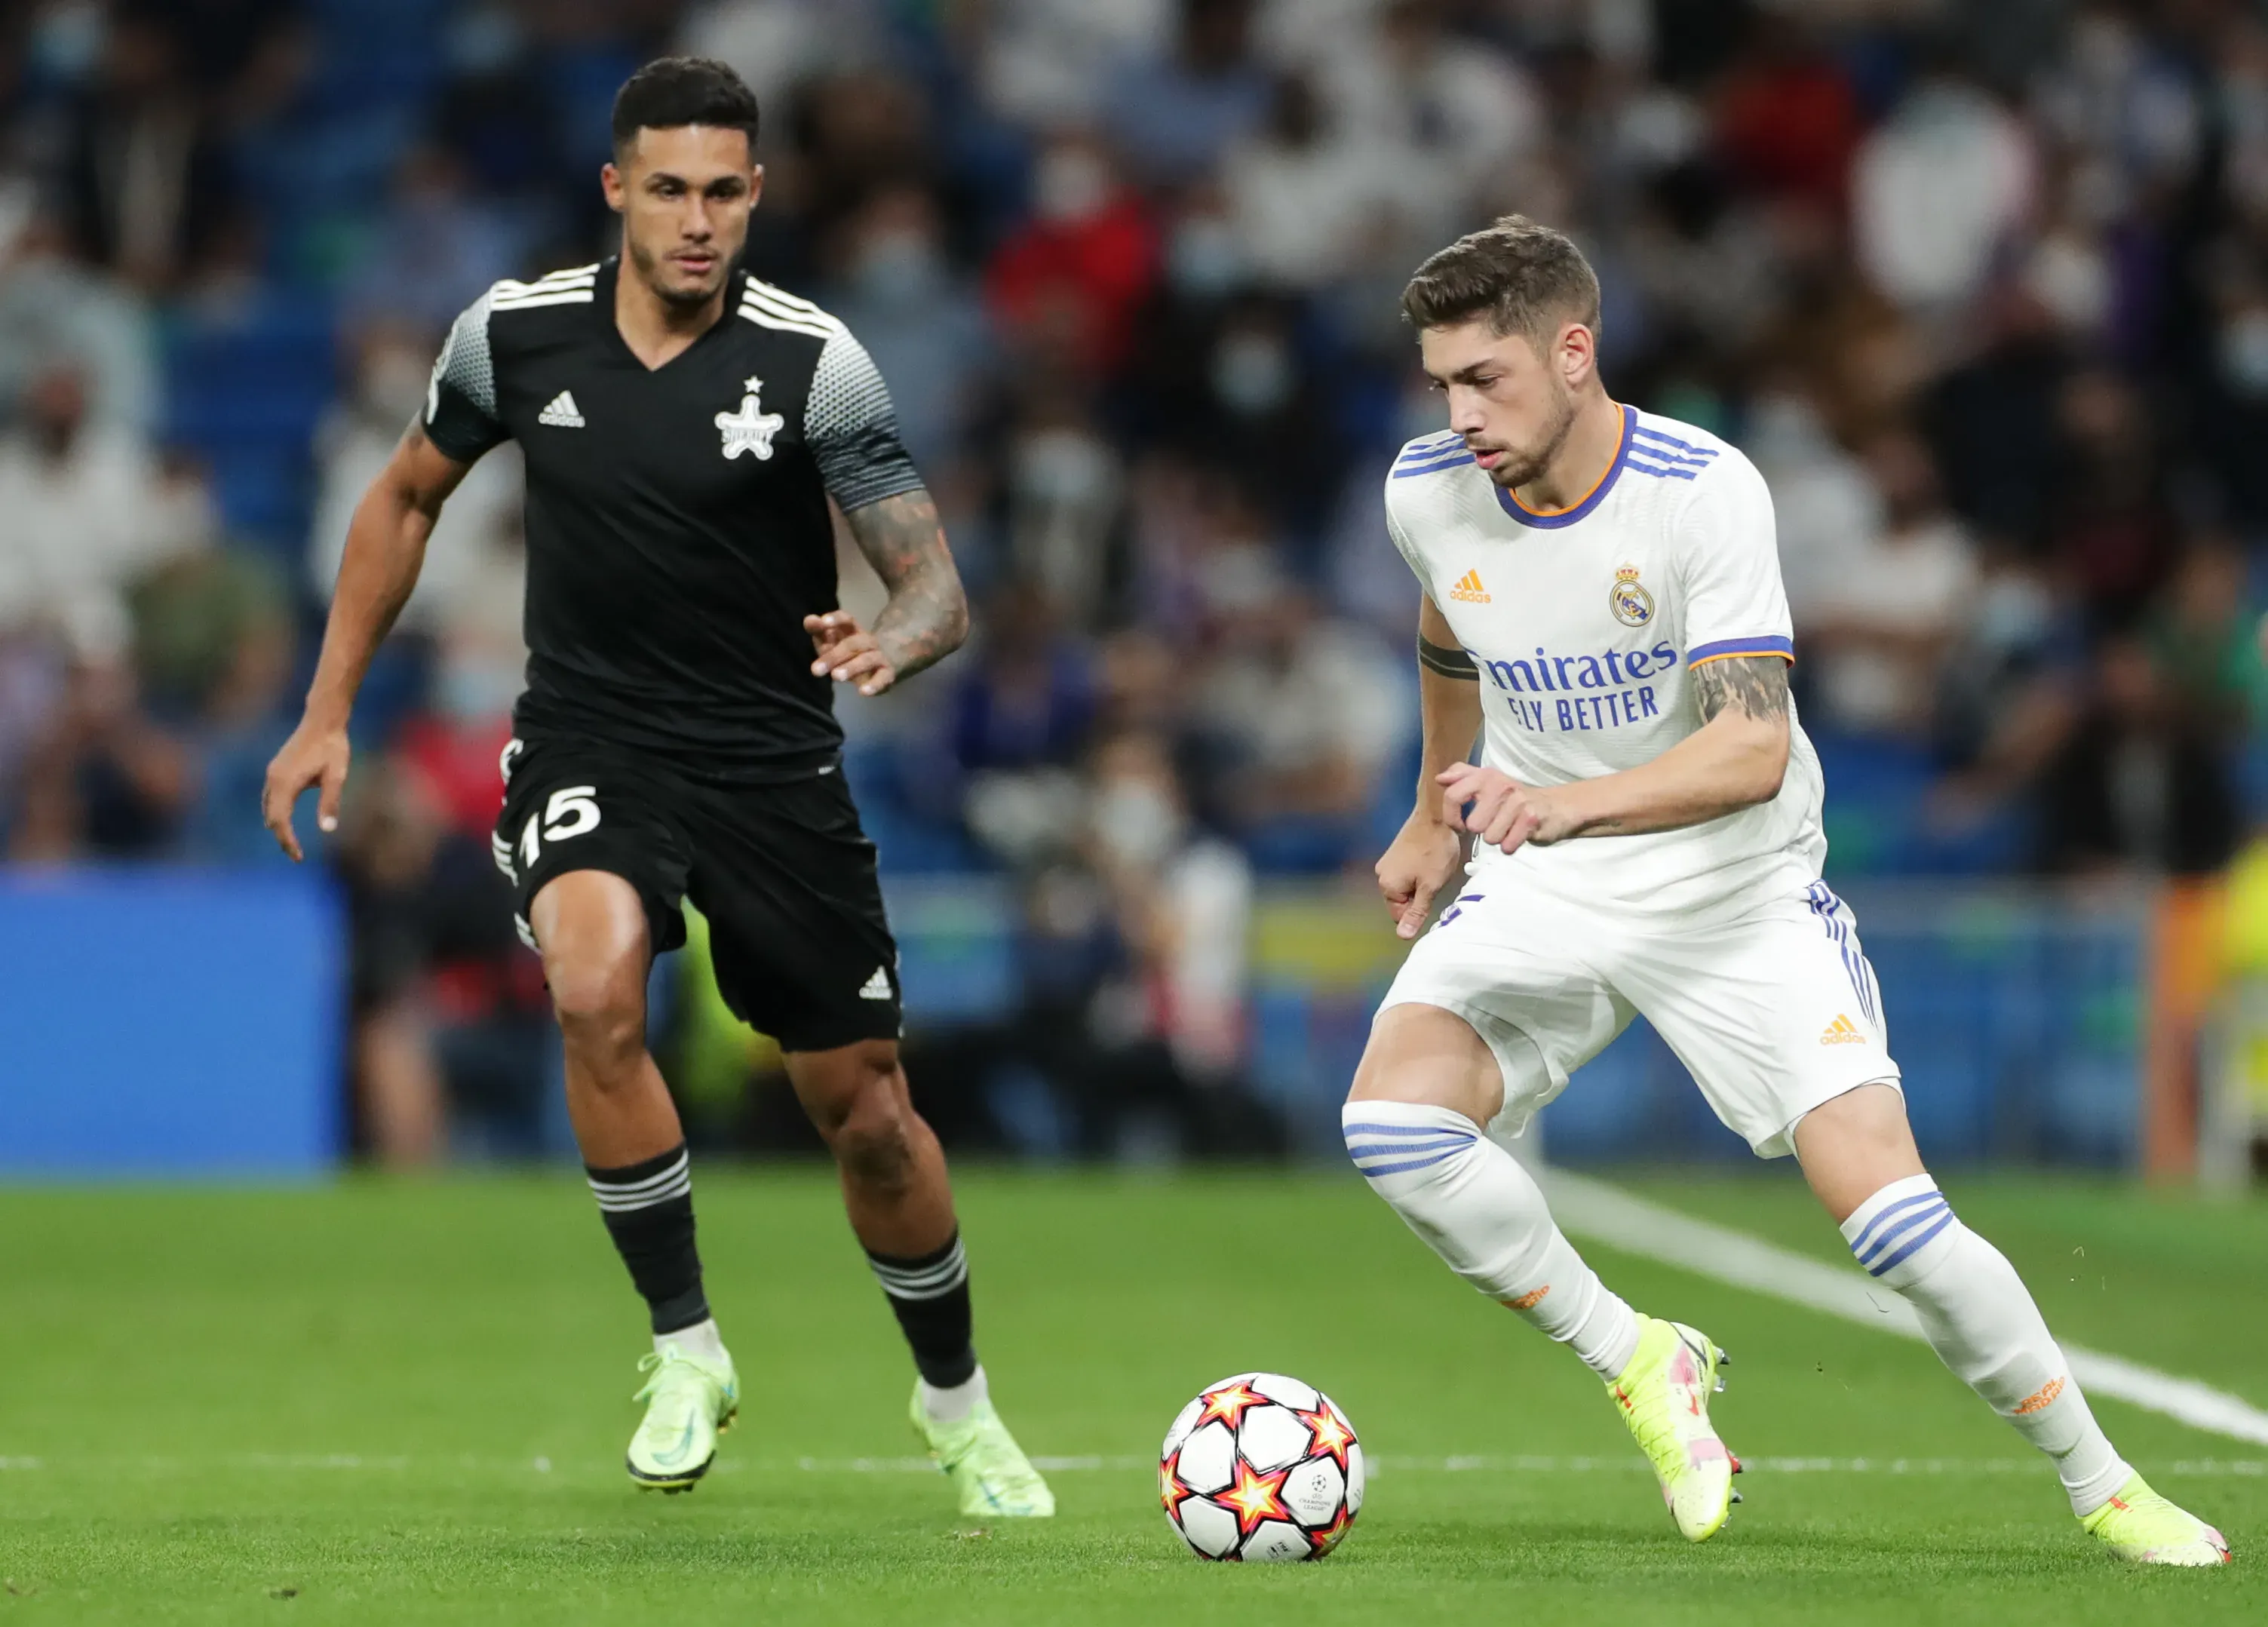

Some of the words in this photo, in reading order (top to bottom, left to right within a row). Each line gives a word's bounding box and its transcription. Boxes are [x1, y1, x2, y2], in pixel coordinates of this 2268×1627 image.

[1450, 590, 1491, 603] adidas
[1465, 640, 1677, 692] mirates
[1507, 697, 1545, 732] FLY
[1555, 686, 1659, 732] BETTER
[519, 785, 601, 869] 15
